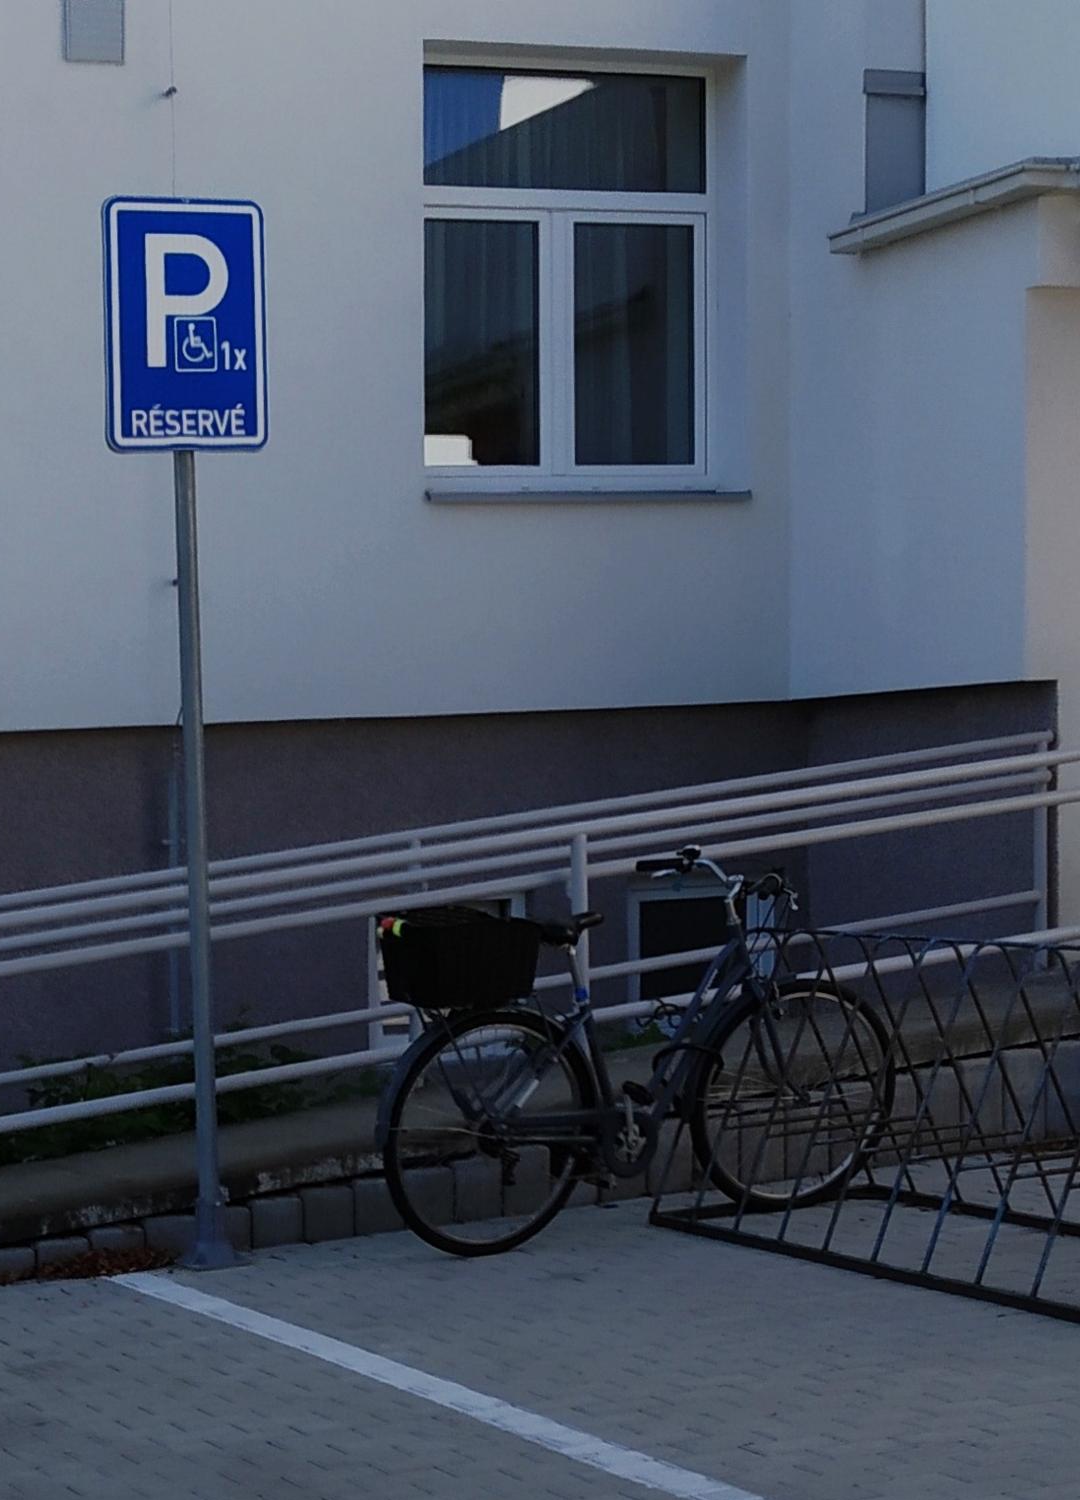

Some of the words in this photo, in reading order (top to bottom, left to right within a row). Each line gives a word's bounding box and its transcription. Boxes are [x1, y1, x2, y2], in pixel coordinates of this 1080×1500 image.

[145, 233, 229, 367] P
[220, 341, 247, 370] 1x
[132, 404, 246, 436] RÉSERVÉ
